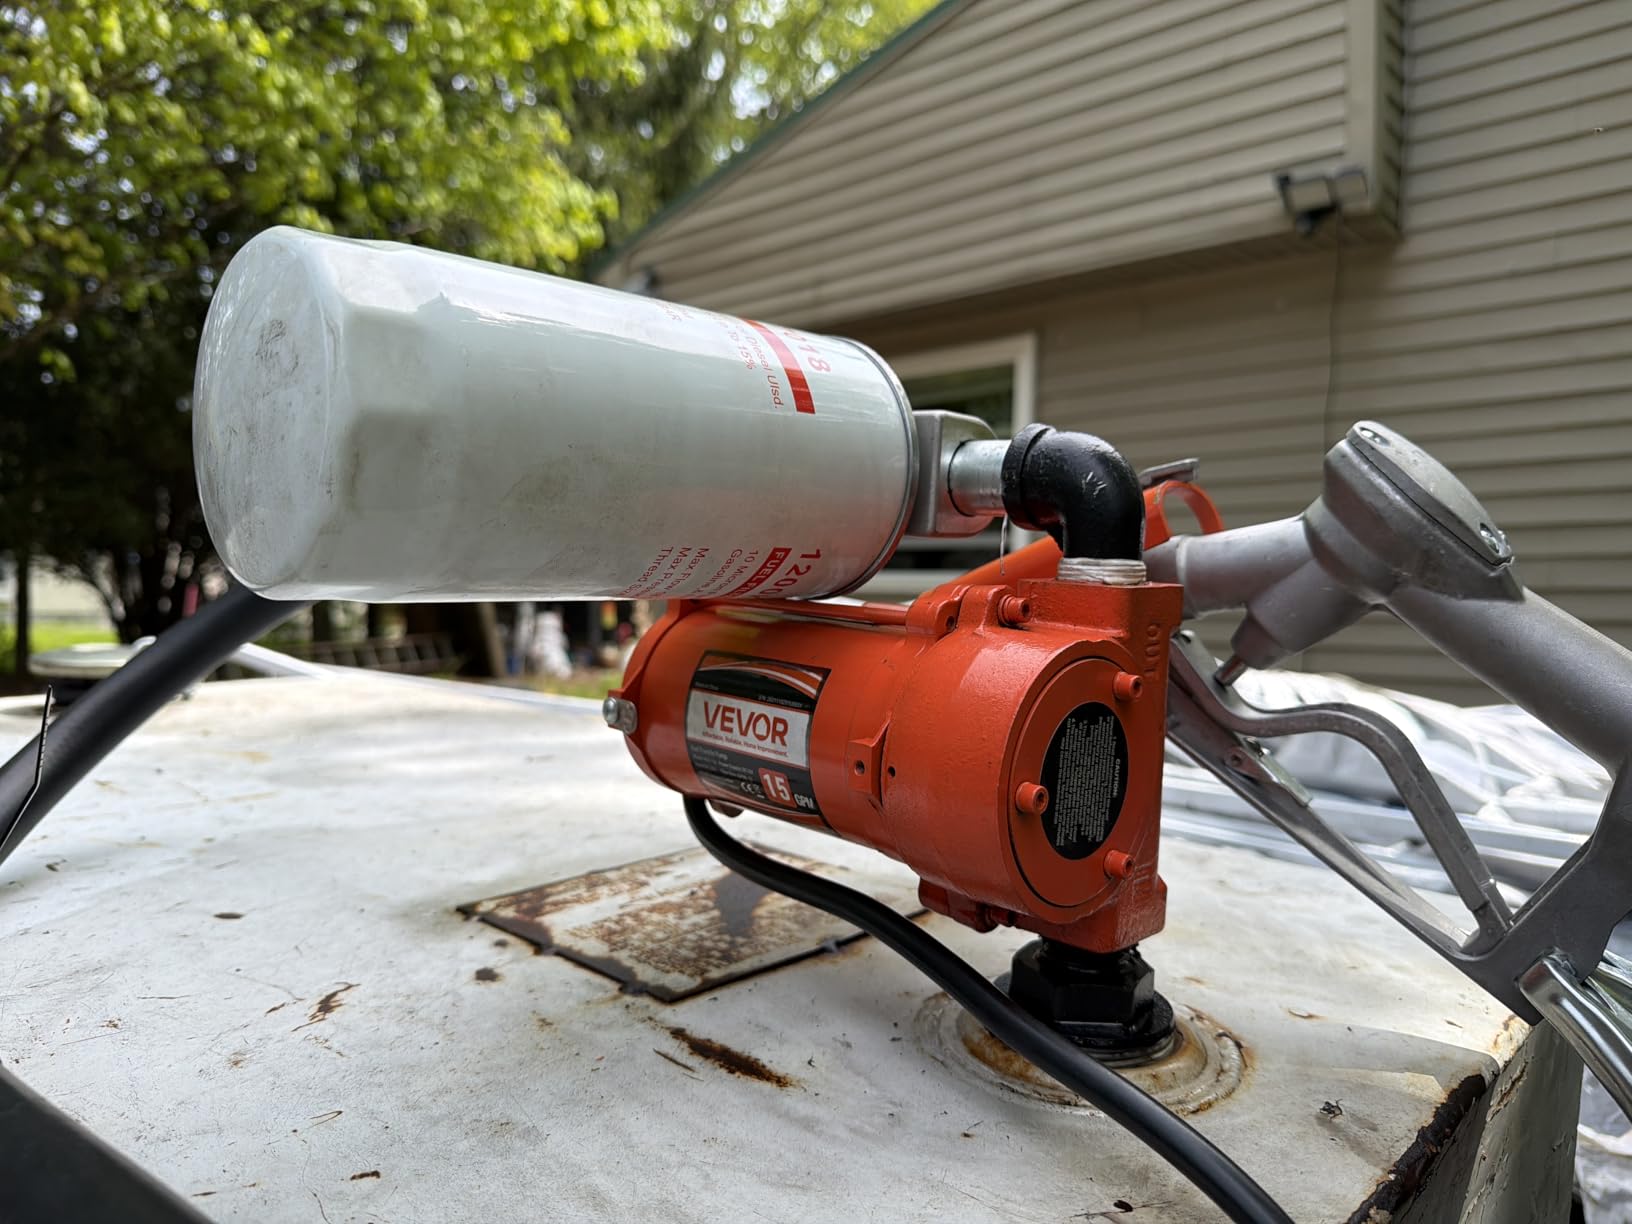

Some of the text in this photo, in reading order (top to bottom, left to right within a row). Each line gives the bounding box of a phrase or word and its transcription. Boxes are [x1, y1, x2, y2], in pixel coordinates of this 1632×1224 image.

[638, 546, 674, 582] Thread
[668, 547, 692, 570] Max
[686, 548, 710, 570] Max
[744, 550, 759, 563] 10
[751, 551, 785, 582] FUEL
[703, 701, 789, 747] VEVOR
[763, 773, 791, 801] 15
